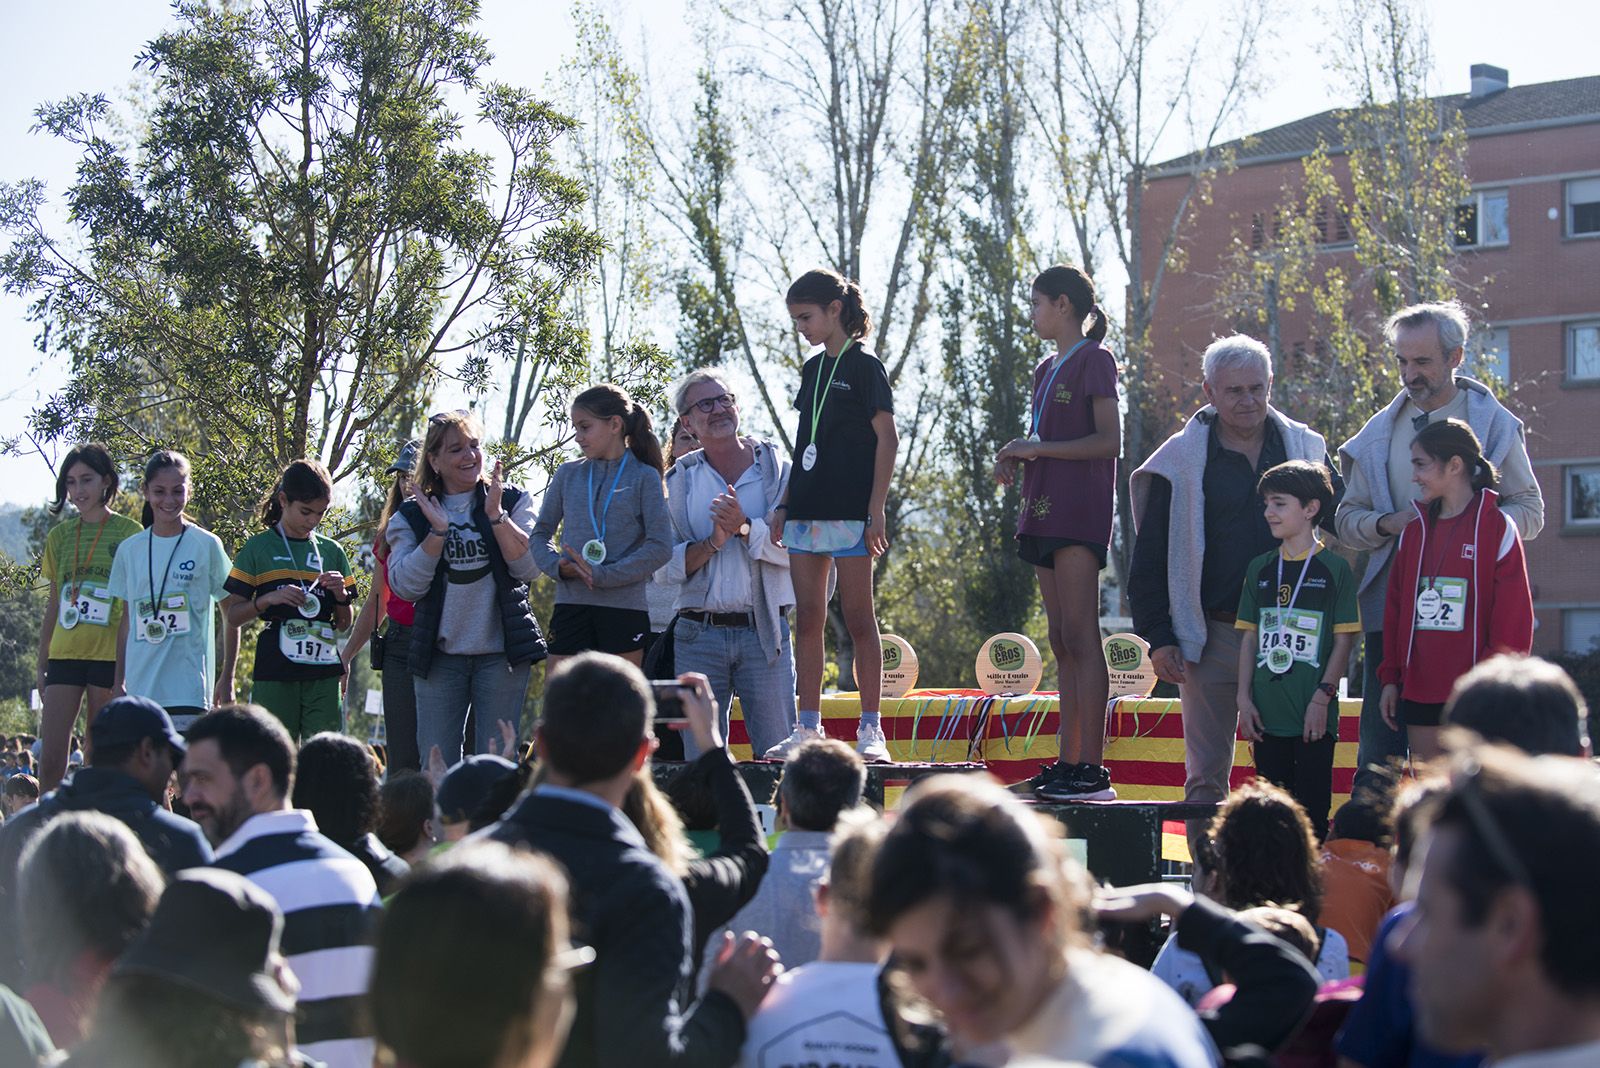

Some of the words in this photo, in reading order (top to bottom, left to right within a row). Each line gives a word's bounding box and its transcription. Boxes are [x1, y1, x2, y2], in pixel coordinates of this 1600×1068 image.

[446, 539, 487, 558] CROS
[296, 641, 322, 657] 157
[1262, 633, 1306, 652] 2035
[883, 647, 897, 660] OS
[994, 647, 1020, 663] CROS
[1110, 647, 1137, 663] CROS
